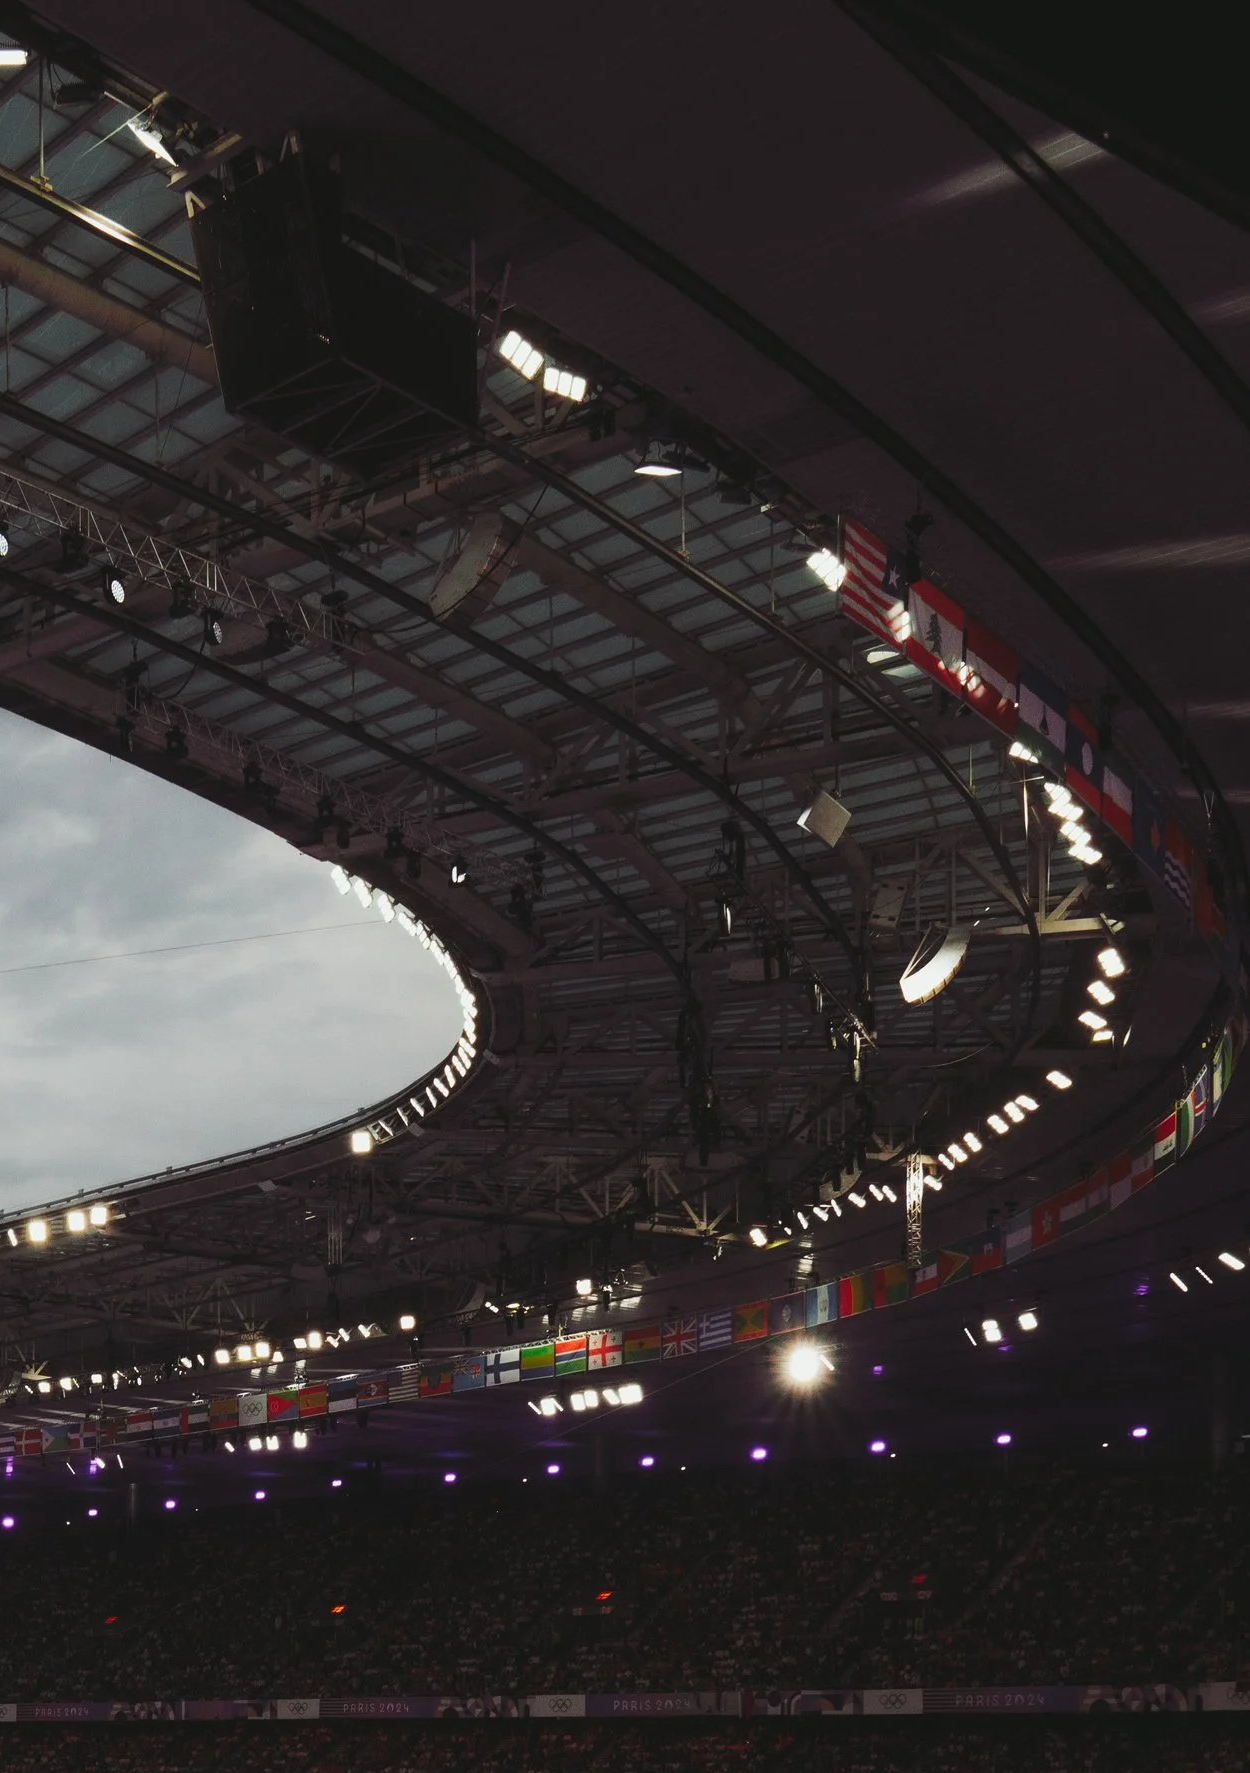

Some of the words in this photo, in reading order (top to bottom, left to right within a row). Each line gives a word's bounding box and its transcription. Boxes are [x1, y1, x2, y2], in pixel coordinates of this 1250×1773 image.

[613, 1700, 651, 1711] PARIS
[655, 1699, 691, 1711] 2024
[956, 1695, 999, 1707] PARIS
[1005, 1694, 1046, 1706] 2024
[35, 1707, 62, 1717] PARIS
[64, 1707, 89, 1717] 2024
[343, 1703, 375, 1713] PARIS
[379, 1703, 409, 1713] 2024
